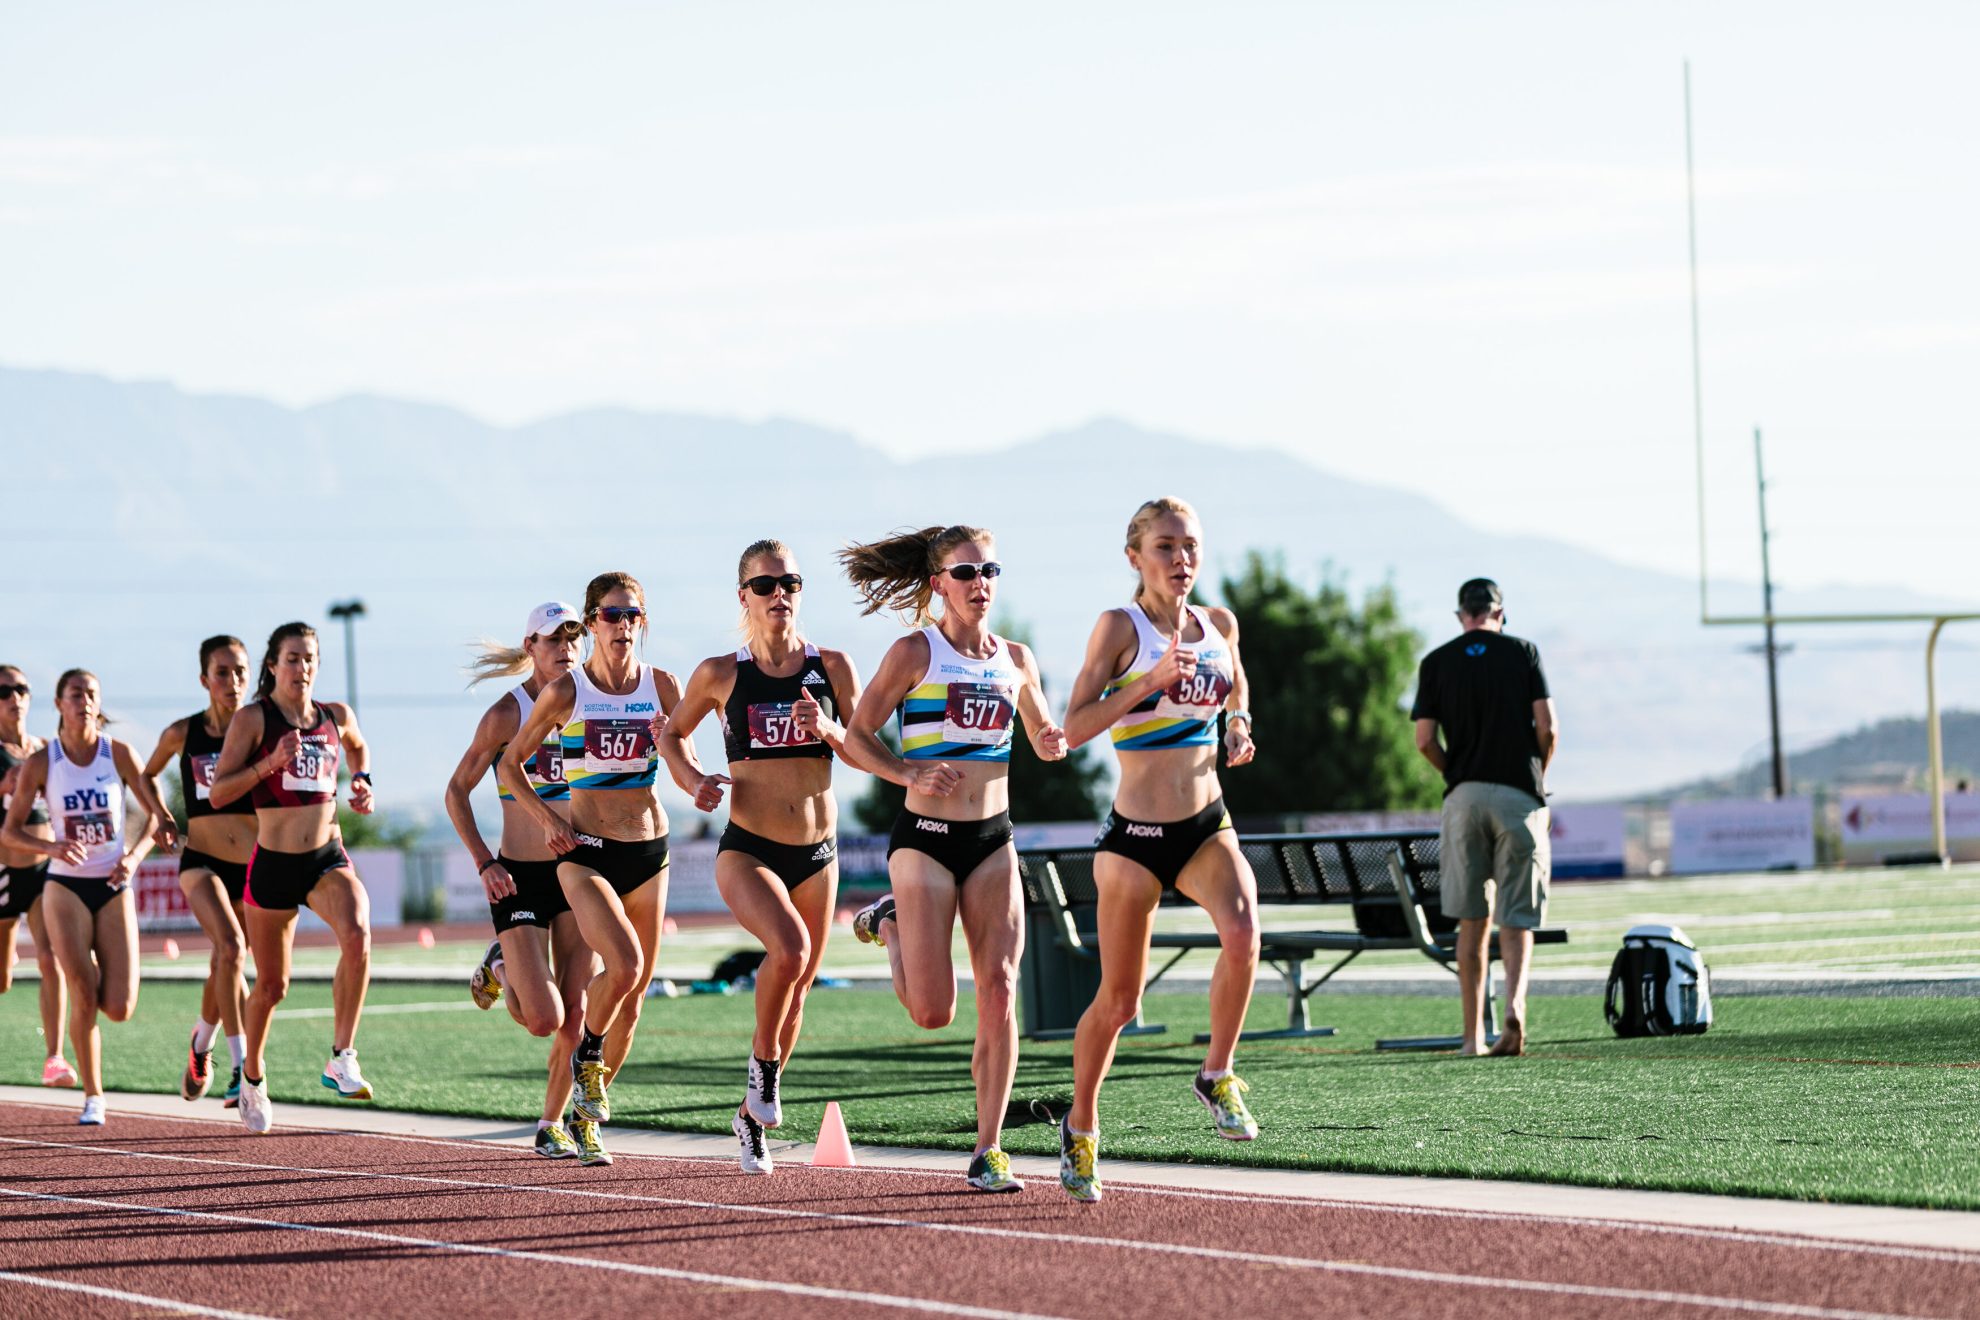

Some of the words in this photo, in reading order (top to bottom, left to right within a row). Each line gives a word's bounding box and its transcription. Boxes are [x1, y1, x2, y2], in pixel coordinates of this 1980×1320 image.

[983, 669, 1010, 679] HO
[1179, 674, 1217, 705] 584
[624, 702, 655, 713] HOKA
[962, 698, 1000, 728] 577
[765, 716, 806, 743] 578
[600, 733, 638, 758] 567
[296, 755, 324, 779] 581
[63, 788, 108, 811] BYU
[75, 823, 107, 845] 583
[916, 818, 949, 834] HOKA
[1126, 823, 1164, 838] HOKA
[811, 850, 834, 861] adidas
[510, 911, 537, 922] HOKA
